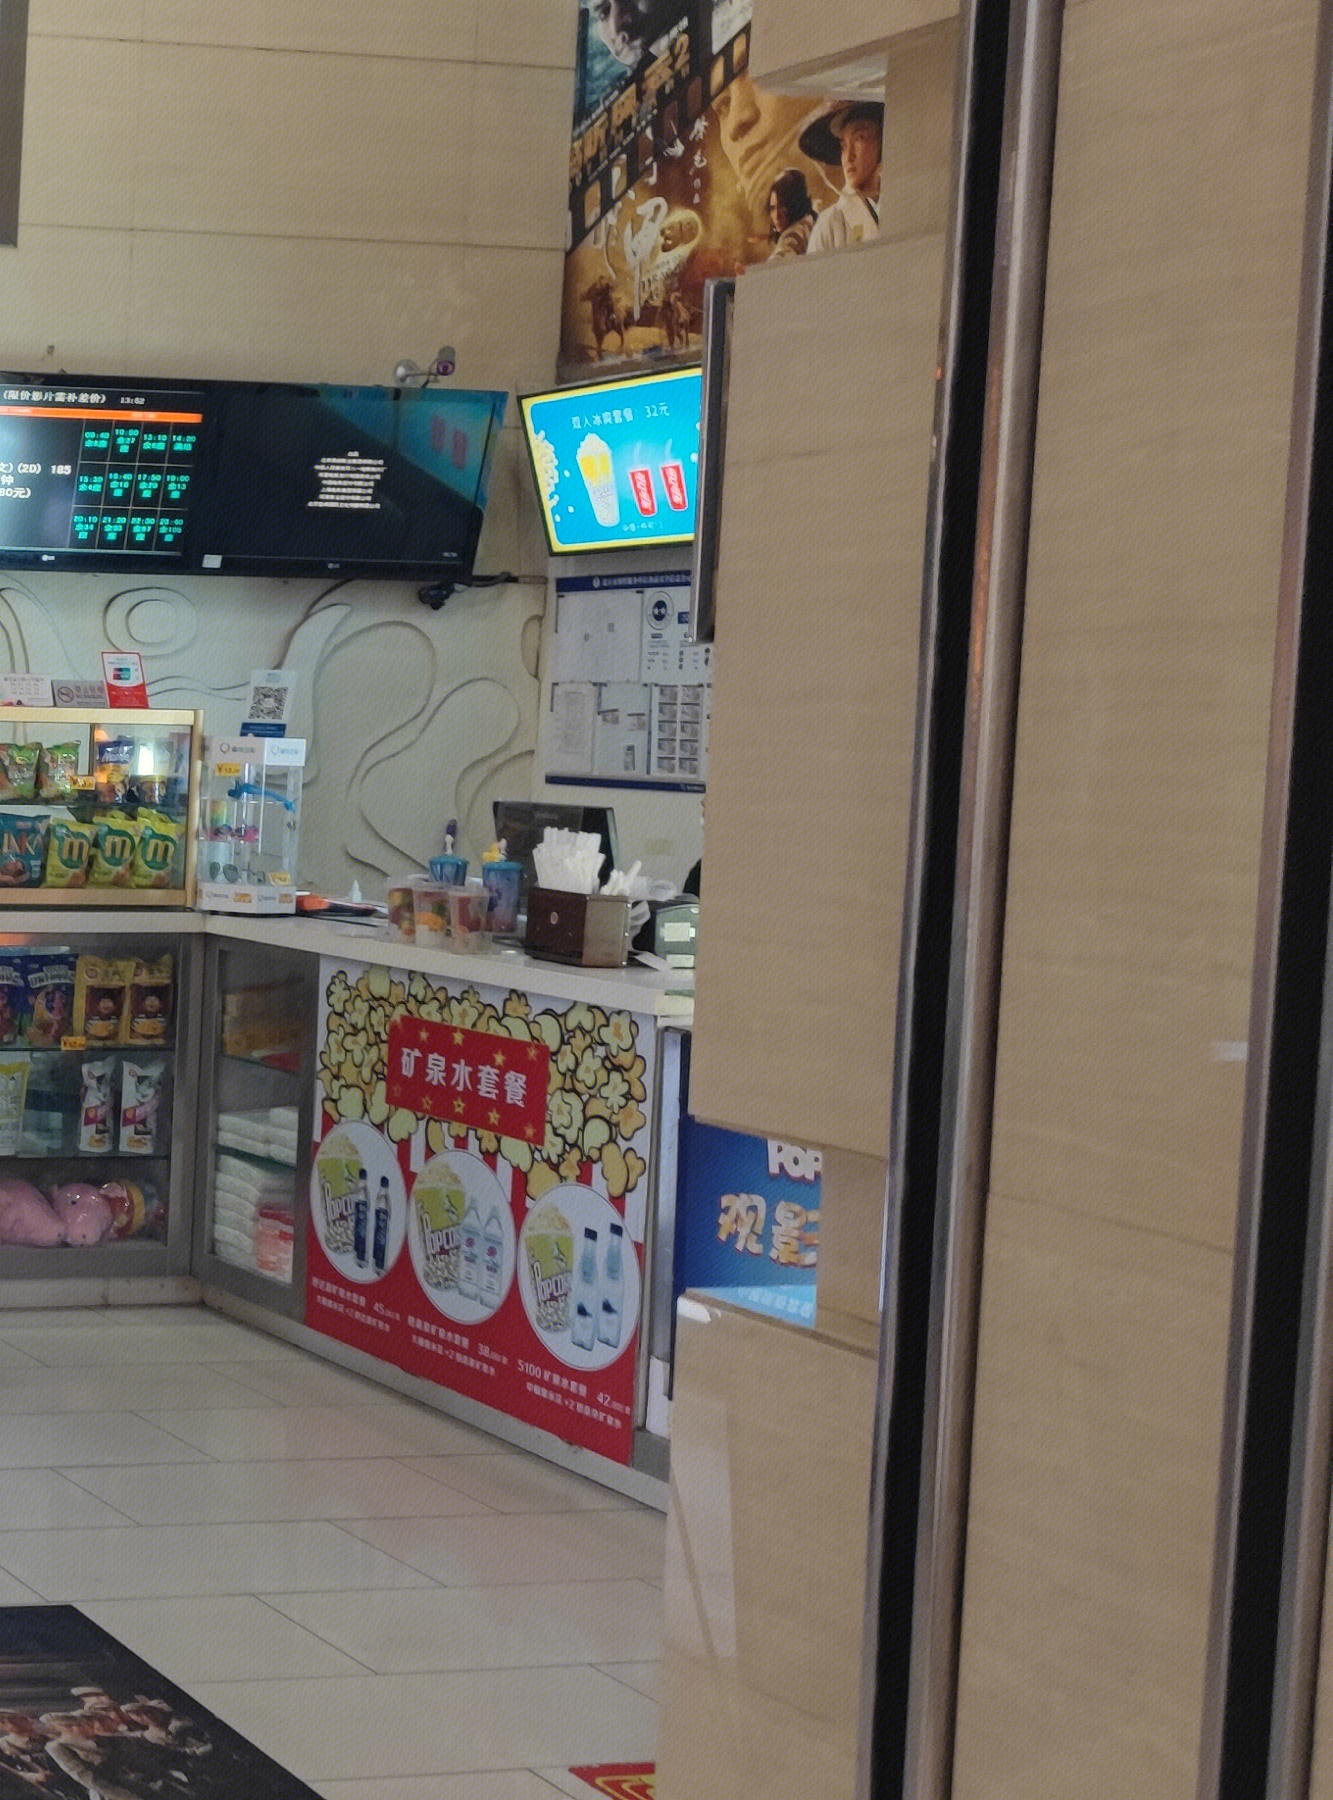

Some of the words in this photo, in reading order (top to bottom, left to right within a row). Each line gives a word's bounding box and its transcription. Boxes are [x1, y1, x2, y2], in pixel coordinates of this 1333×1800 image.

[51, 465, 71, 475] 185
[400, 1046, 528, 1109] 矿泉水套餐
